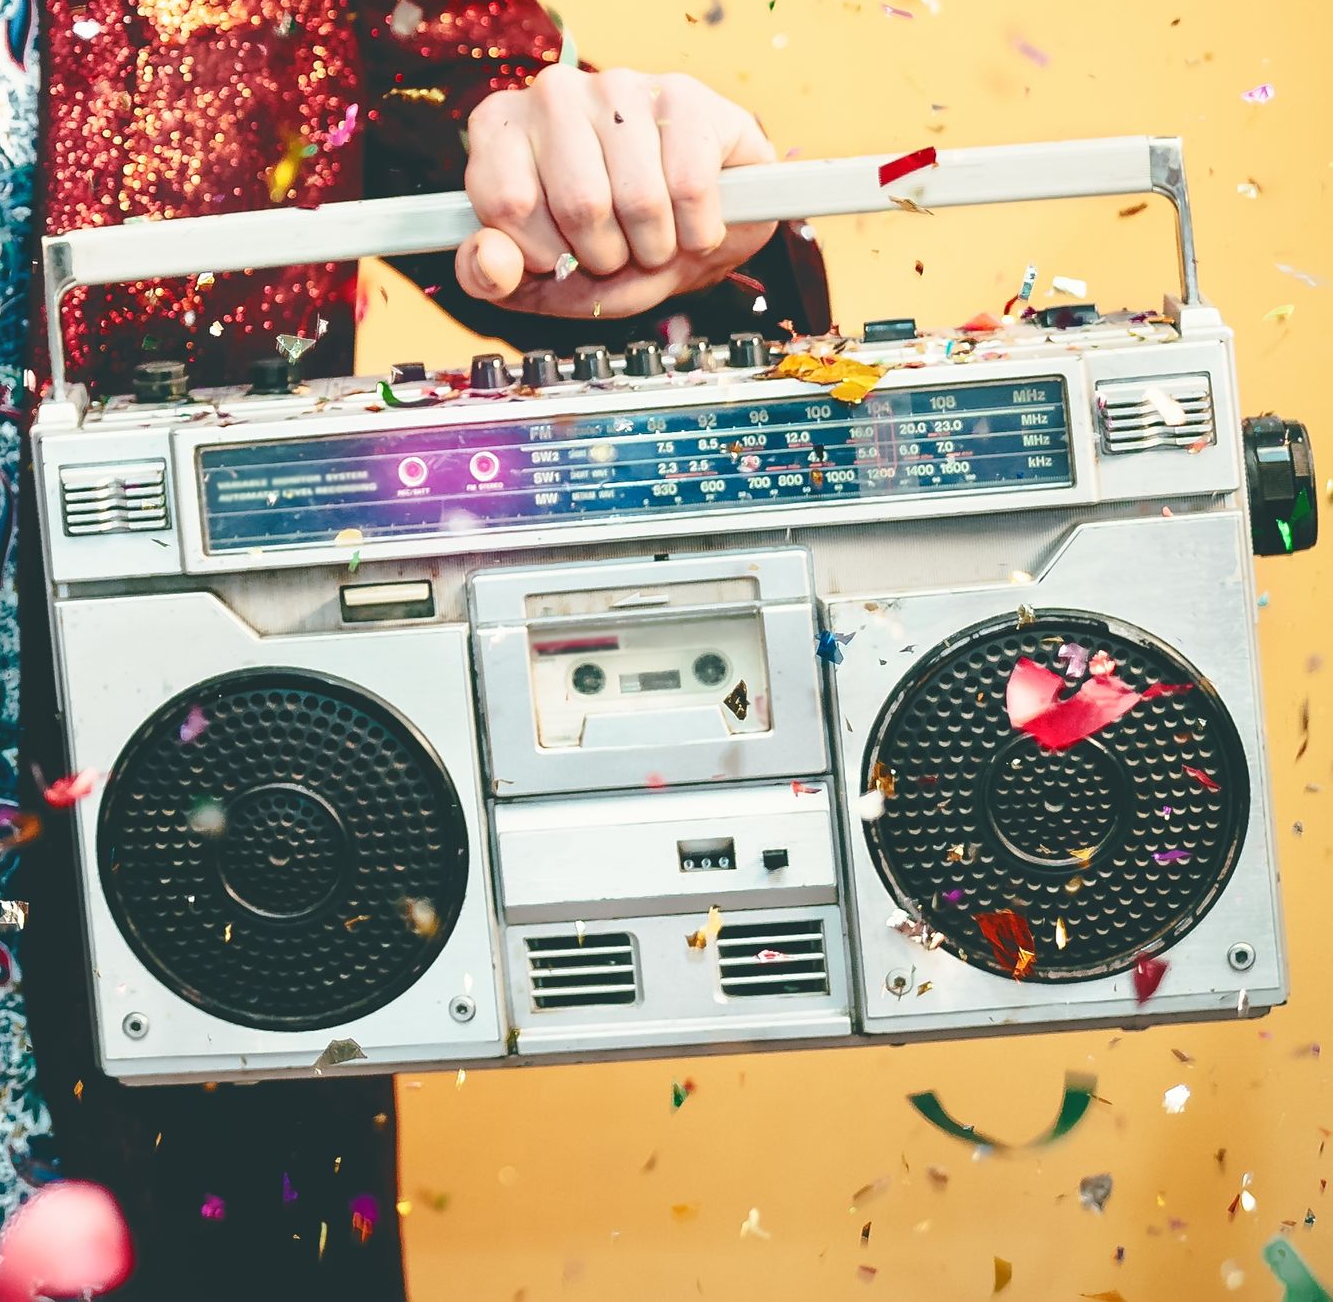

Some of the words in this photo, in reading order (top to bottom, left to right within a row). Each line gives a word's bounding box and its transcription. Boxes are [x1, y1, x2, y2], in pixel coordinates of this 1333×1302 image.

[530, 425, 551, 440] FM
[698, 414, 717, 428] 92
[805, 405, 831, 419] 100
[865, 401, 890, 414] 104
[930, 395, 956, 409] 108
[1013, 389, 1046, 403] MHz
[532, 451, 560, 463] SW2
[657, 442, 674, 453] 7.5
[698, 438, 718, 450] 8.5
[742, 434, 767, 446] 10.0
[785, 431, 810, 443] 12.0
[849, 426, 873, 438] 16.0
[899, 422, 927, 435] 20.0
[934, 420, 962, 432] 23.0
[1021, 414, 1048, 426] MHz
[533, 471, 560, 484] SW1
[658, 462, 677, 475] 2.3
[689, 460, 709, 472] 2.5
[859, 447, 877, 458] 5.0
[899, 444, 919, 456] 6.0
[936, 441, 954, 453] 7.0
[1023, 434, 1050, 446] MHz
[535, 493, 558, 506] MW
[700, 480, 726, 493] 600
[747, 476, 771, 489] 700
[778, 474, 803, 486] 800
[825, 470, 855, 482] 1000
[867, 467, 895, 479] 1200
[905, 464, 934, 476] 1400
[940, 461, 970, 474] 1600
[1028, 456, 1052, 468] kHz
